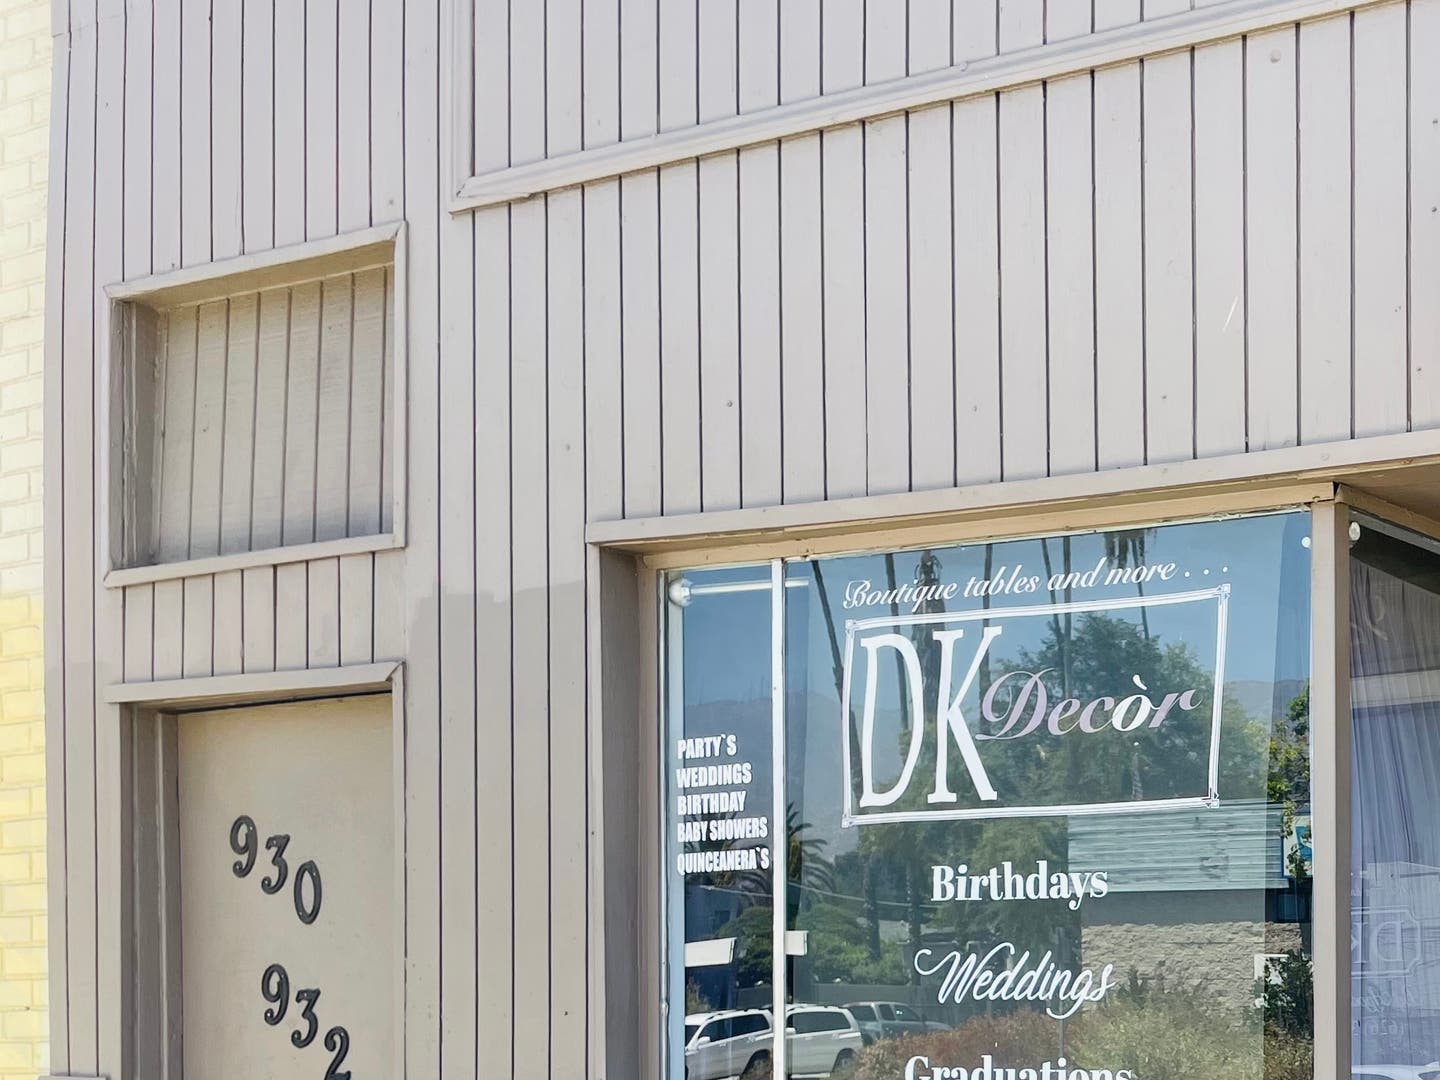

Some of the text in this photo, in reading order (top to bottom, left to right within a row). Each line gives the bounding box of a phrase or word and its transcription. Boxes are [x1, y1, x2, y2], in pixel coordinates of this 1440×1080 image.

[843, 579, 959, 613] Boutique
[964, 565, 1040, 600] tables
[1047, 557, 1107, 591] and
[859, 626, 1202, 808] DK Decòr
[676, 762, 752, 788] WEDDINGS
[677, 791, 747, 816] BIRTHDAY
[677, 816, 768, 843] BABY SHOWERS
[230, 815, 322, 925] 930
[931, 861, 1108, 910] Birthdays
[914, 942, 1115, 1020] Weddings
